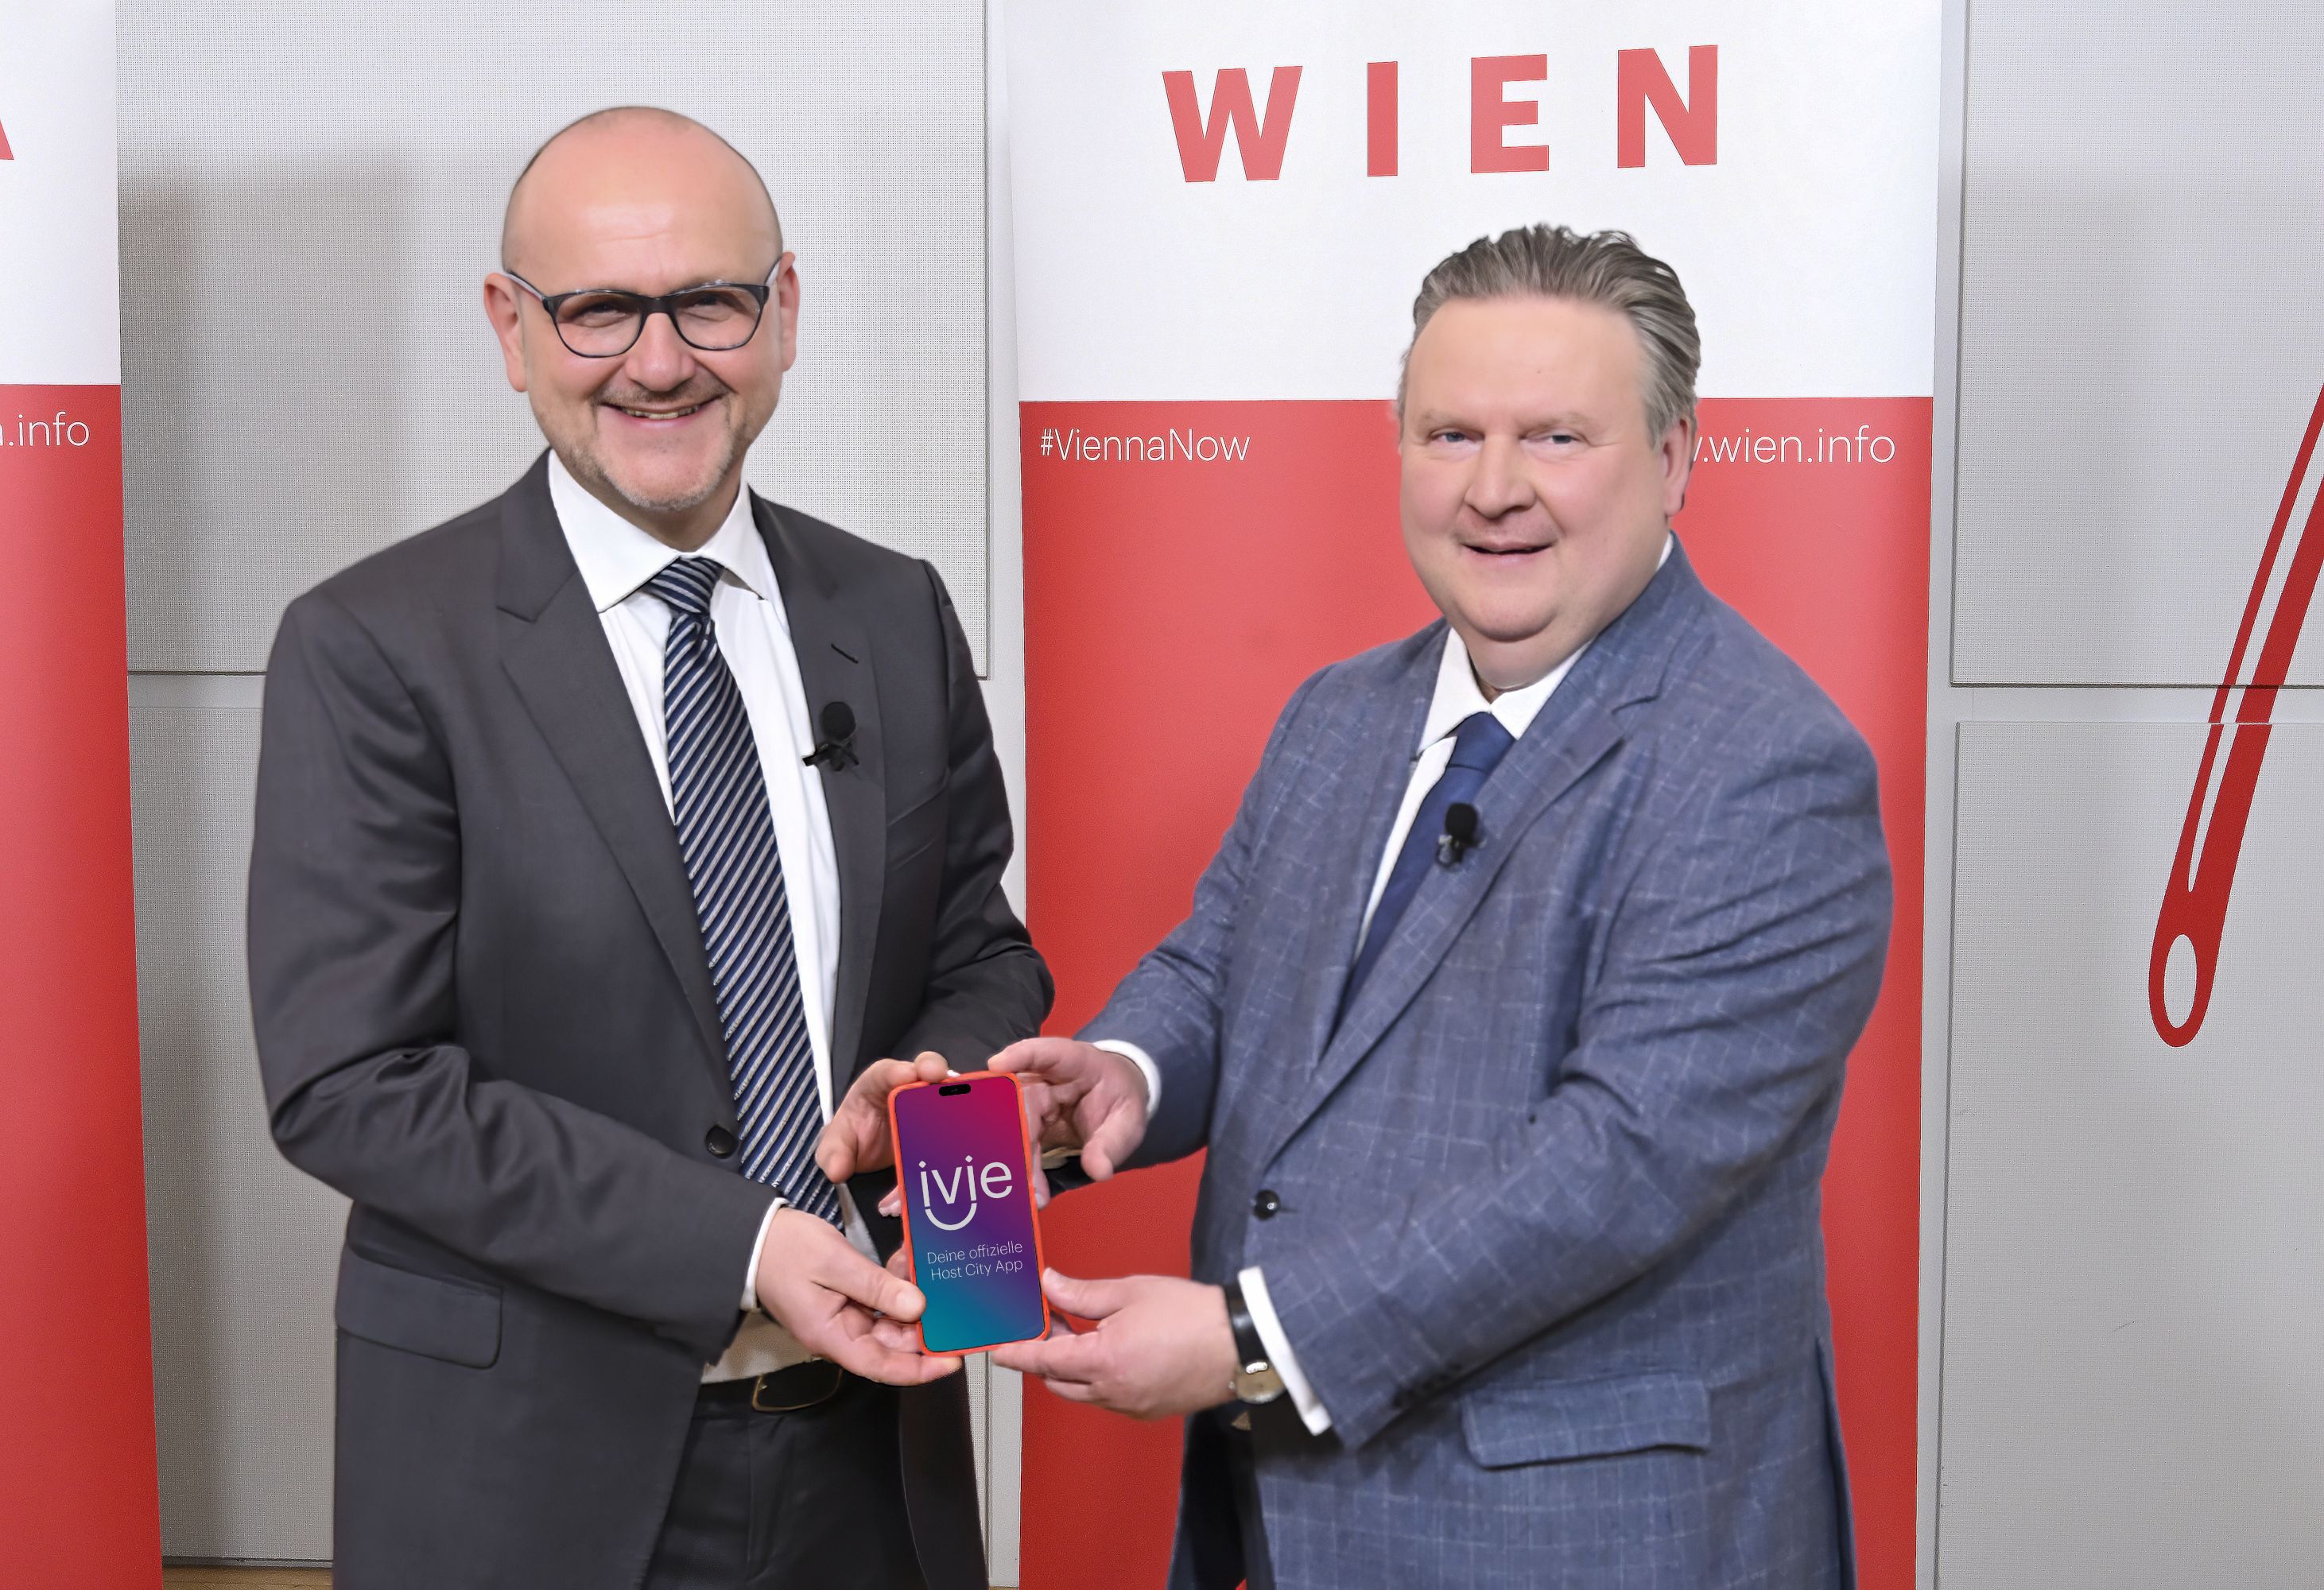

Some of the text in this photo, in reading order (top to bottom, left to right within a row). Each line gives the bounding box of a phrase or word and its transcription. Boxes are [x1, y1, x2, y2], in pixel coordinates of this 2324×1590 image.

[1162, 45, 1718, 183] WIEN
[0, 410, 90, 447] .info
[1040, 428, 1251, 461] #ViennaNow
[927, 1241, 1022, 1264] Deine offizielle
[931, 1259, 1023, 1281] Host City App
